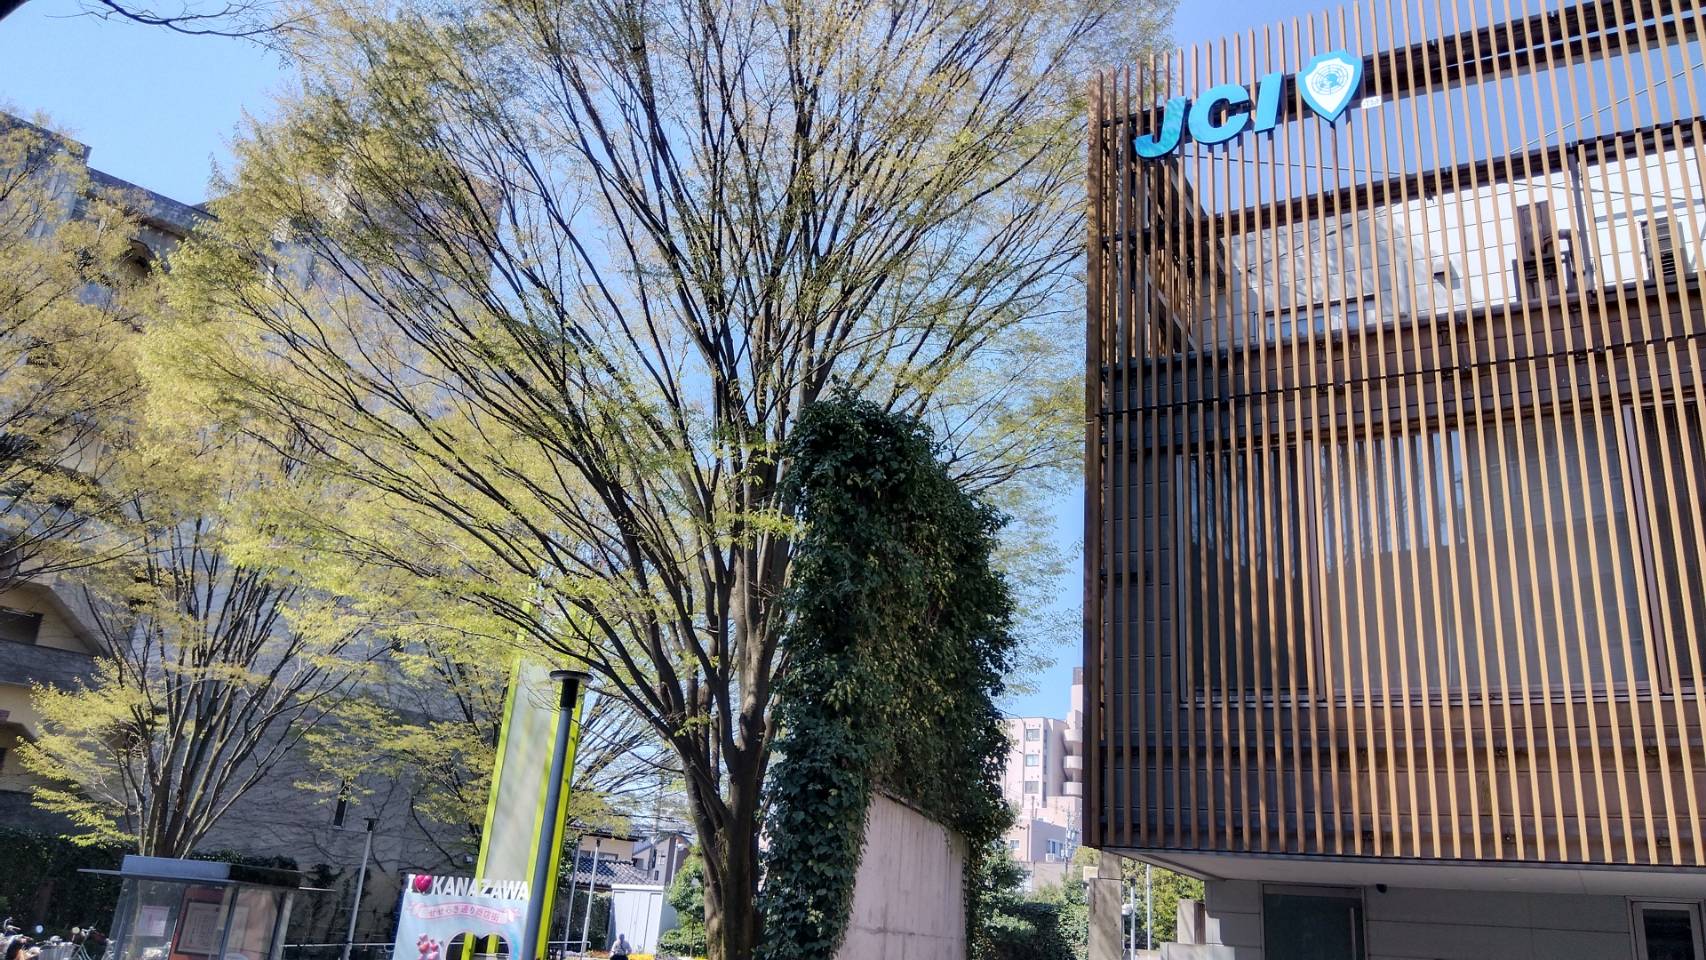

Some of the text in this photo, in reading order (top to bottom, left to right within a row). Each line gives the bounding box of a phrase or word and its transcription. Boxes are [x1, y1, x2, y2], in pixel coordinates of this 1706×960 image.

[1134, 72, 1283, 158] JCI
[407, 874, 529, 900] I KANAZAWA
